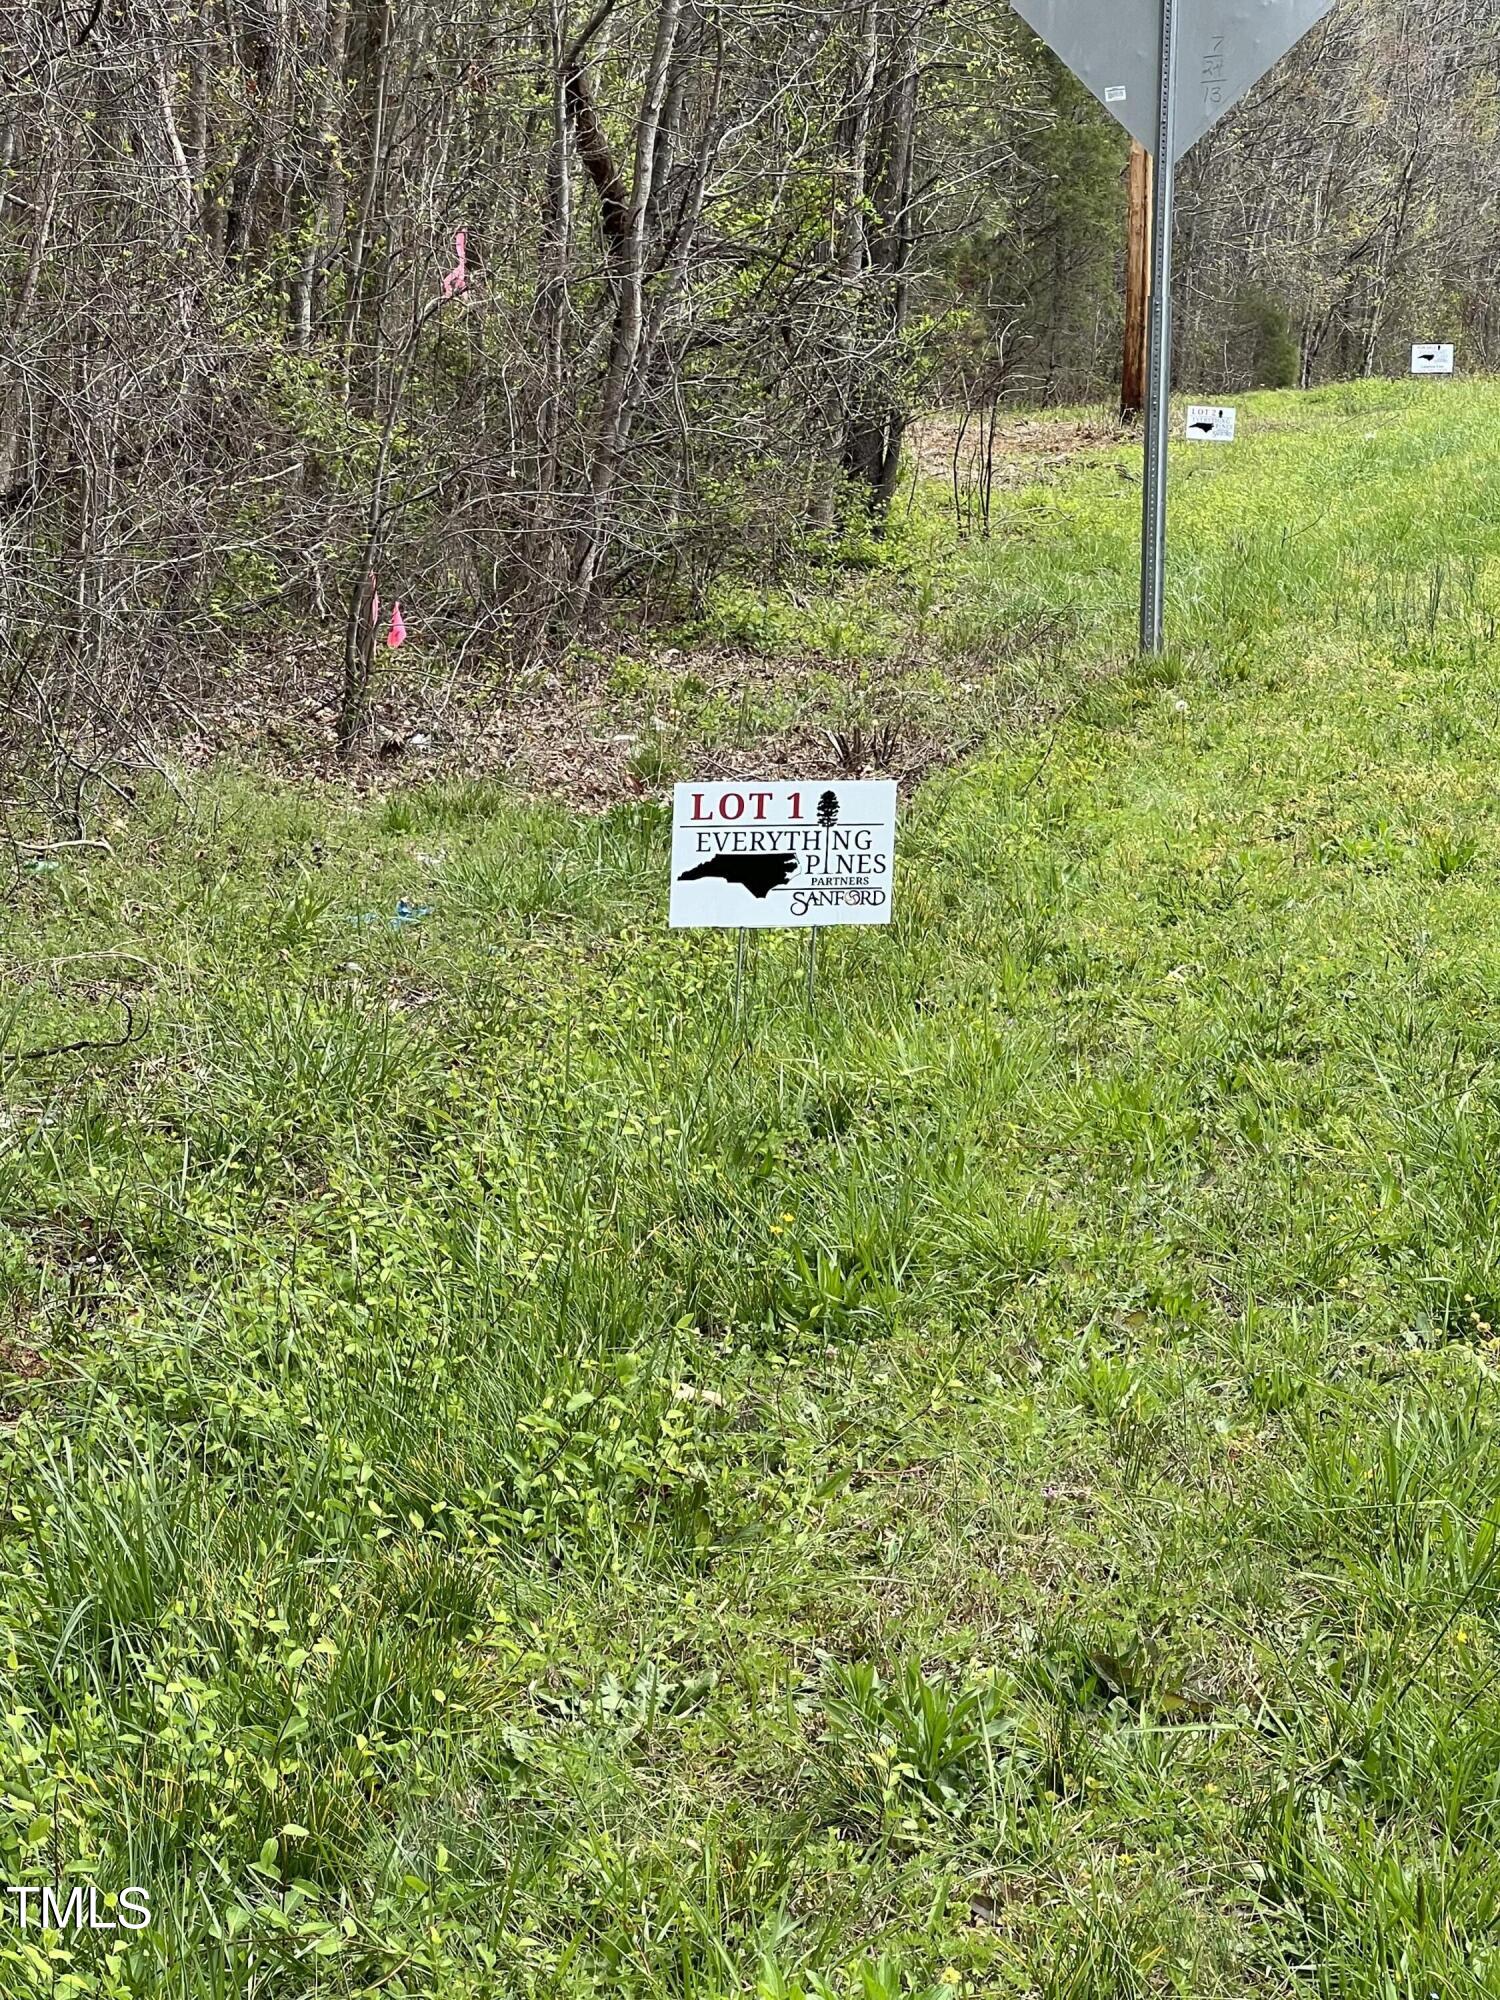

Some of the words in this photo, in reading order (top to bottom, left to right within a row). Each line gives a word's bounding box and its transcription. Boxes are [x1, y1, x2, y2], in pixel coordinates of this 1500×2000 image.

[1203, 86, 1222, 104] 13
[690, 793, 773, 820] LOT
[787, 792, 804, 819] 1
[695, 829, 873, 853] EVERYTHING
[804, 853, 886, 875] PINES
[811, 876, 870, 887] PARTNERS
[790, 890, 886, 916] SANFORD
